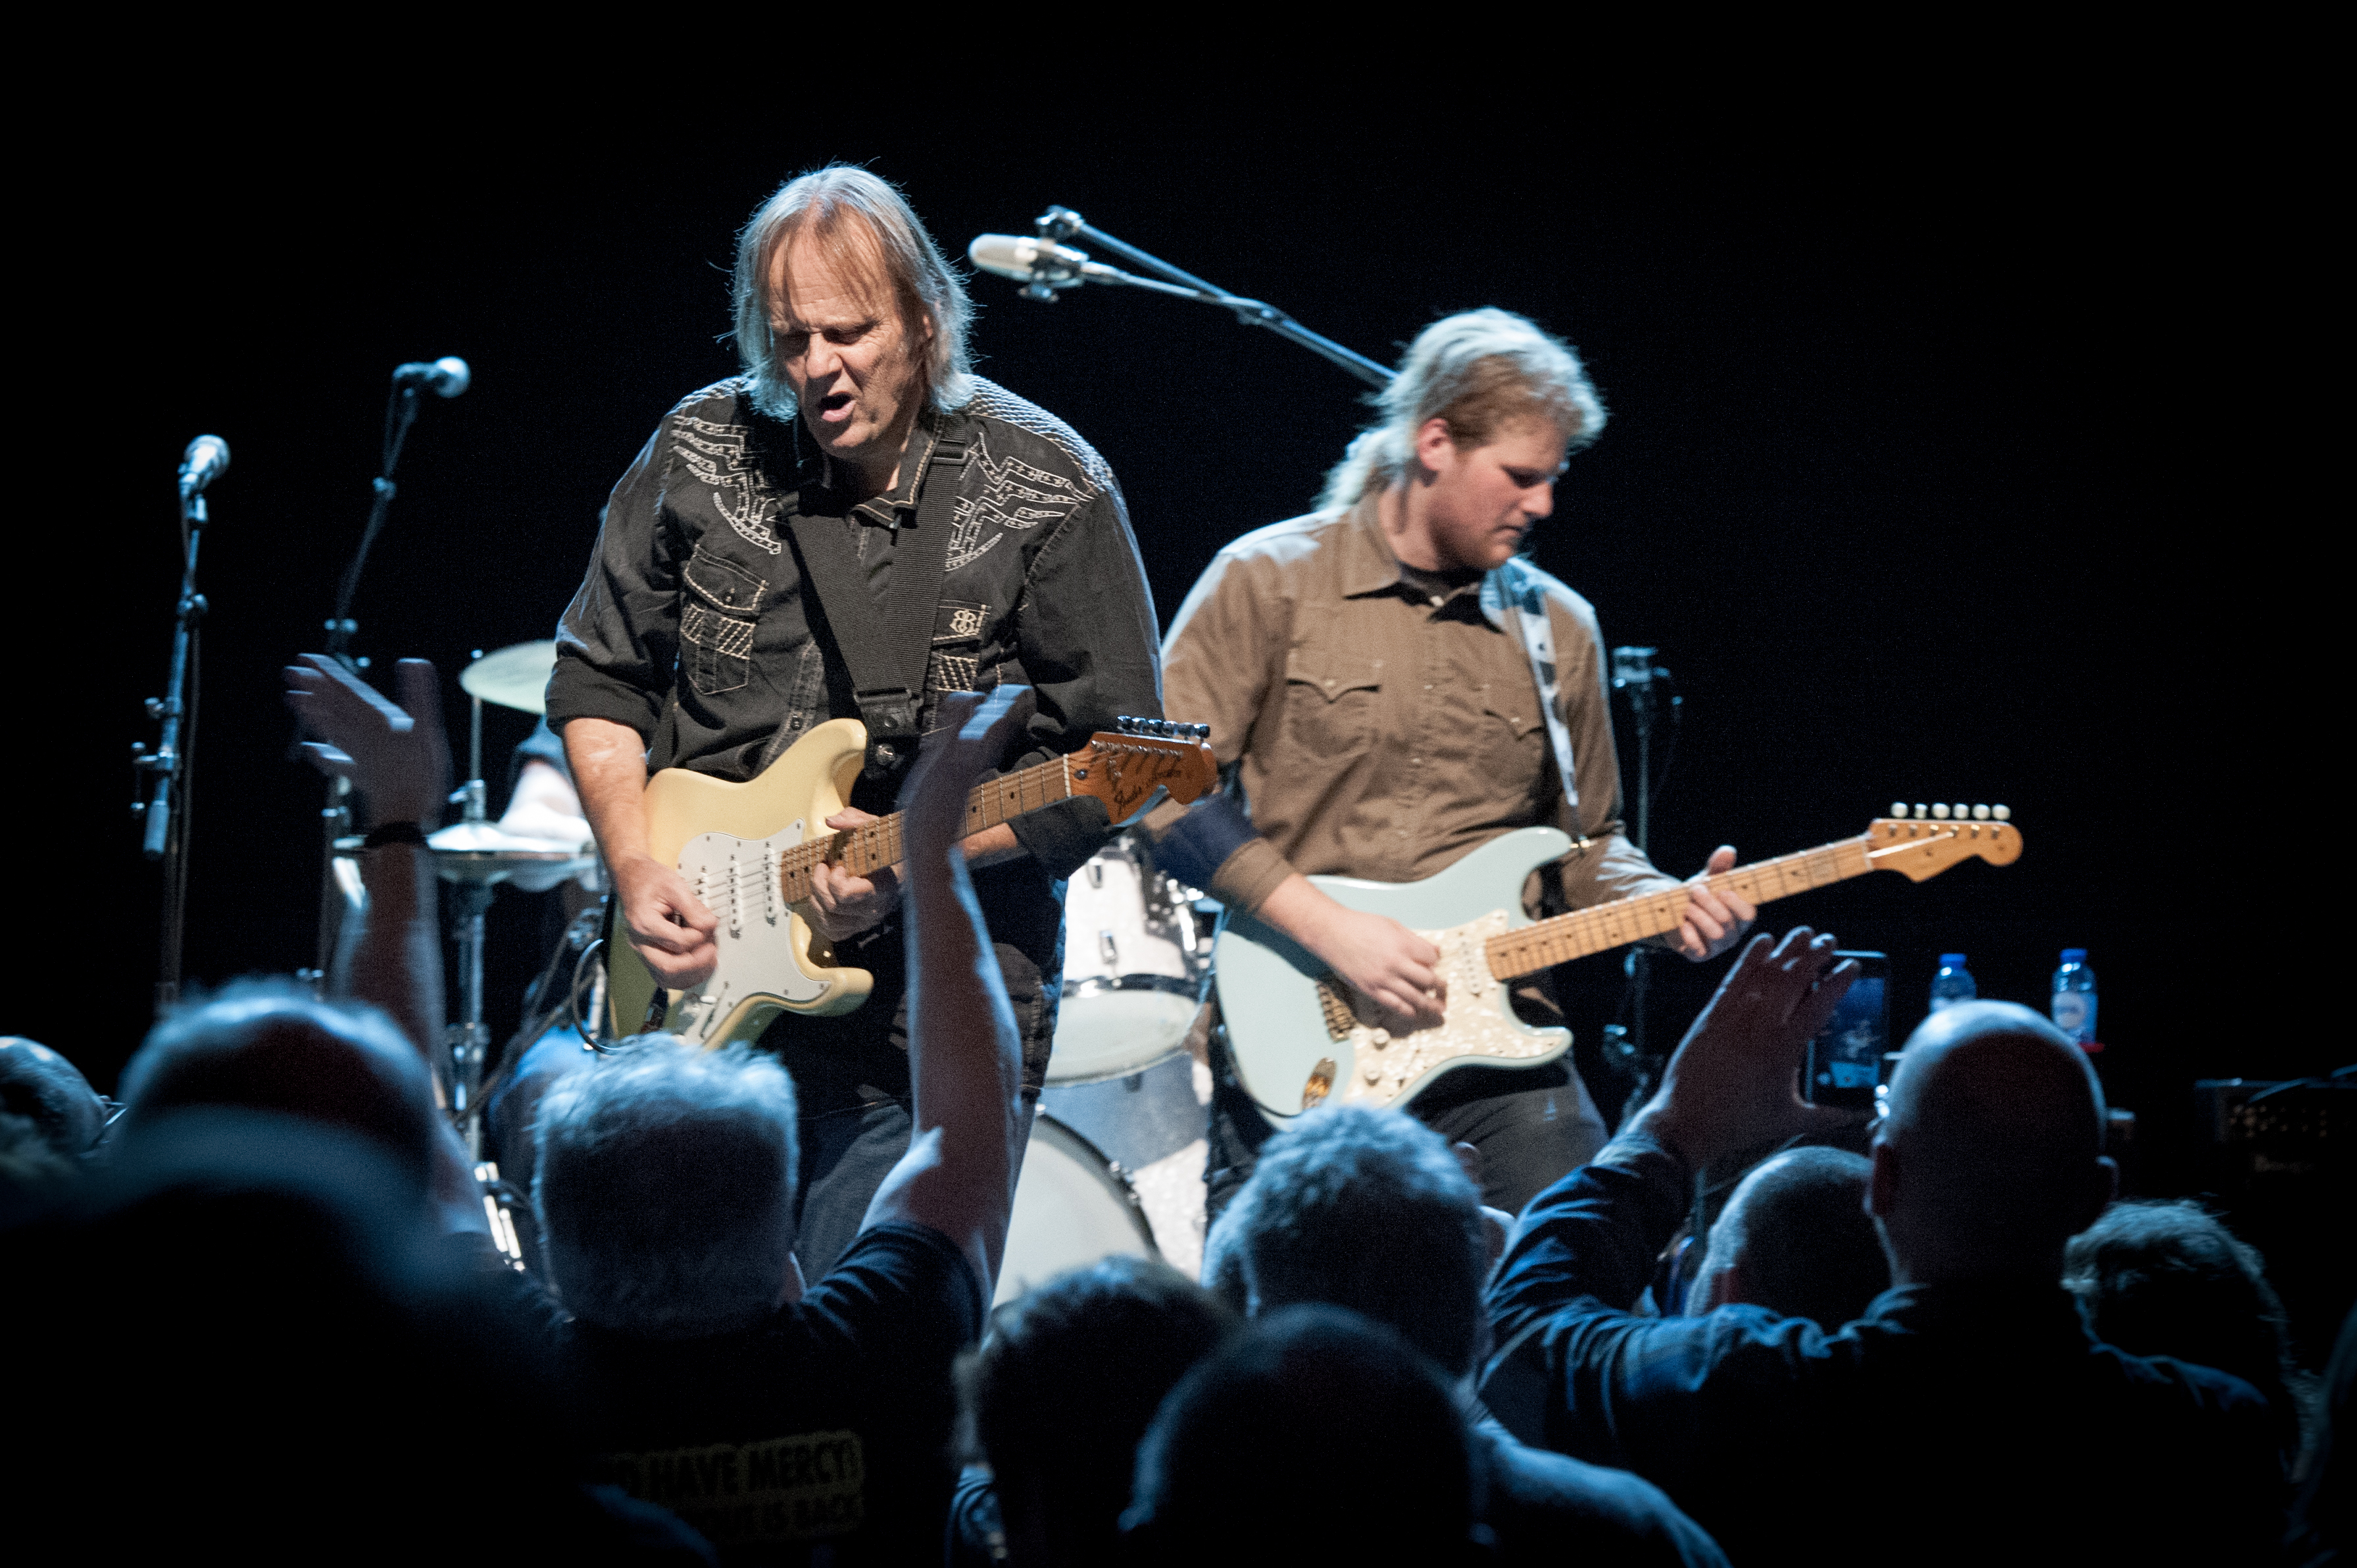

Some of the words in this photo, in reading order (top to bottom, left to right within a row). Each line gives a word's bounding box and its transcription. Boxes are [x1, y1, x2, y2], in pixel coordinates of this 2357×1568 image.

[650, 1454, 737, 1500] HAVE
[749, 1442, 858, 1490] MERCY!
[763, 1502, 786, 1532] IS
[796, 1496, 856, 1529] BACK
